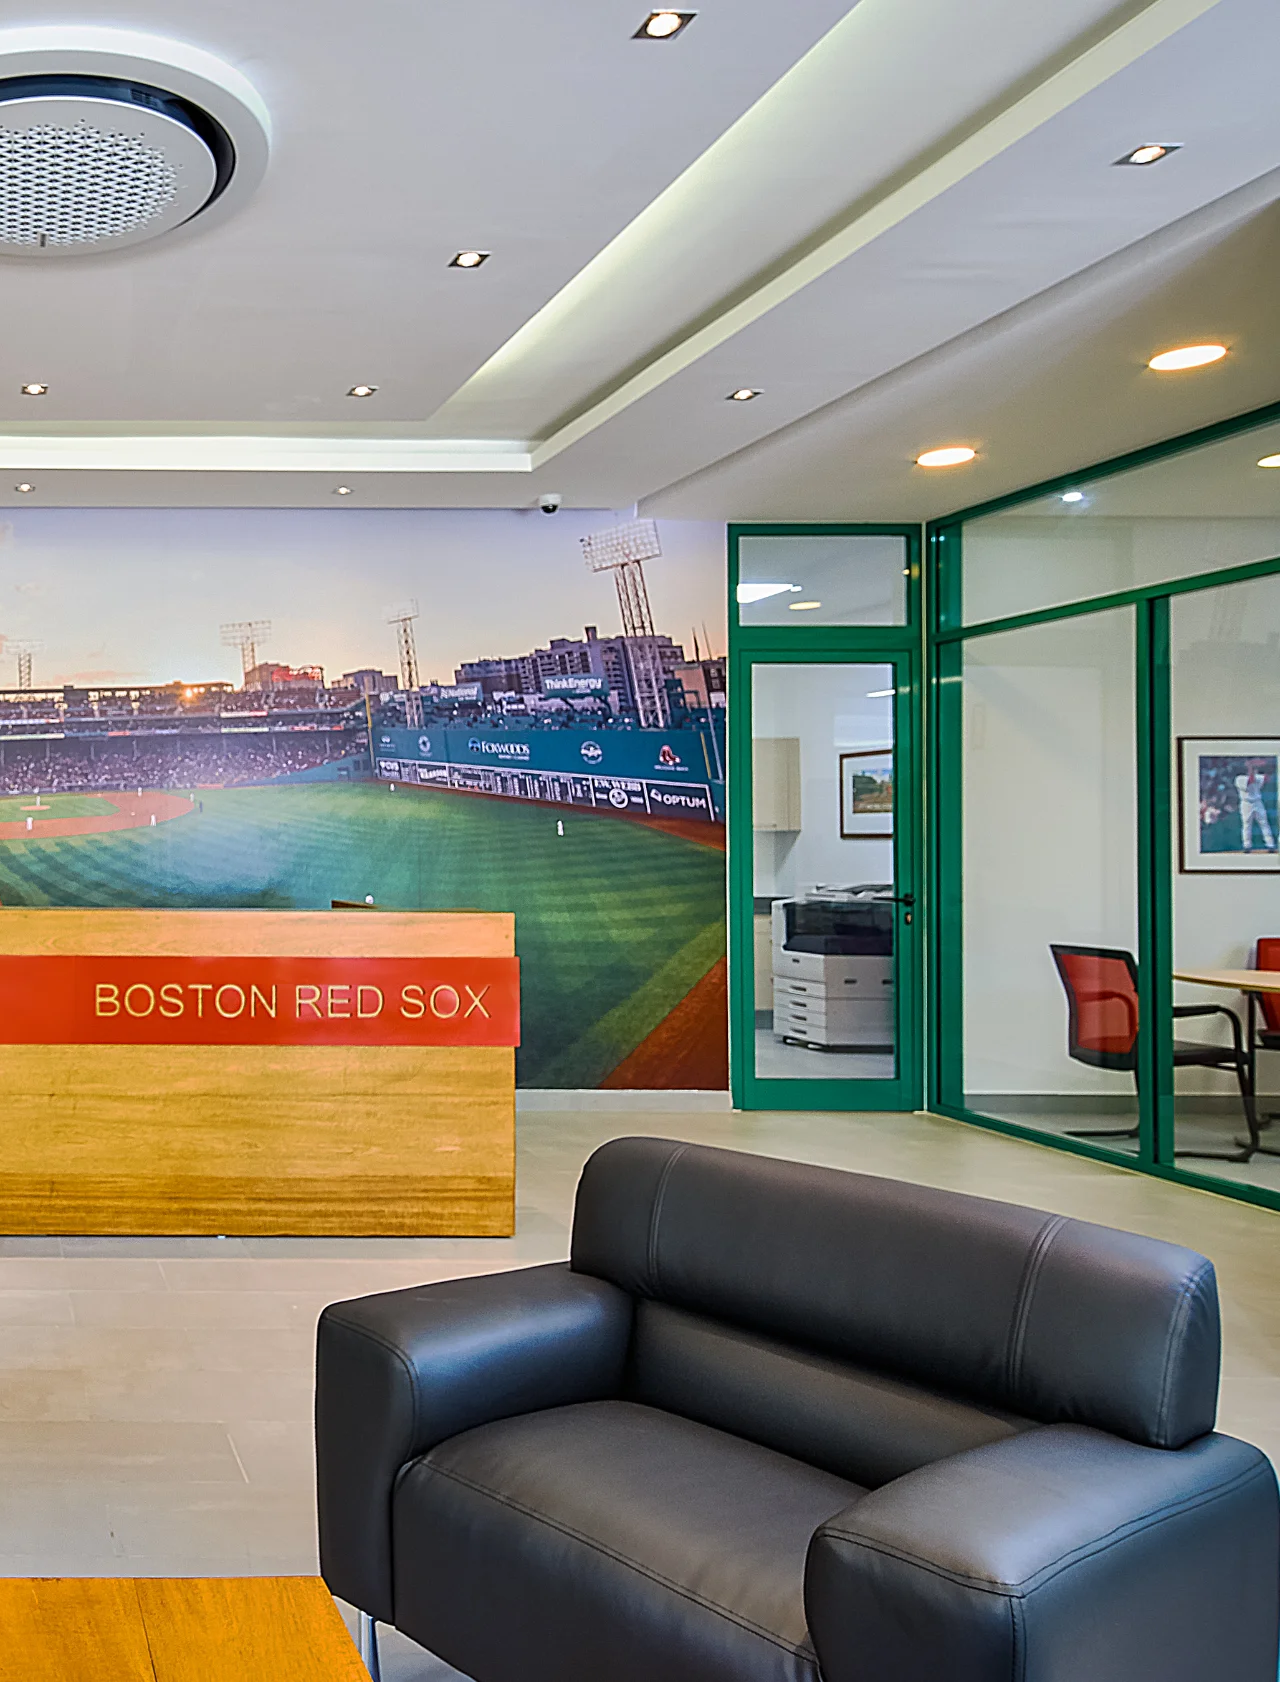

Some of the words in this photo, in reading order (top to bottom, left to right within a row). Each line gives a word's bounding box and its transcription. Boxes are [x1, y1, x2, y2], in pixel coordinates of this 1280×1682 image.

[663, 794, 706, 809] OPTUM
[95, 984, 277, 1018] BOSTON
[296, 985, 386, 1019] RED
[400, 985, 492, 1019] SOX
